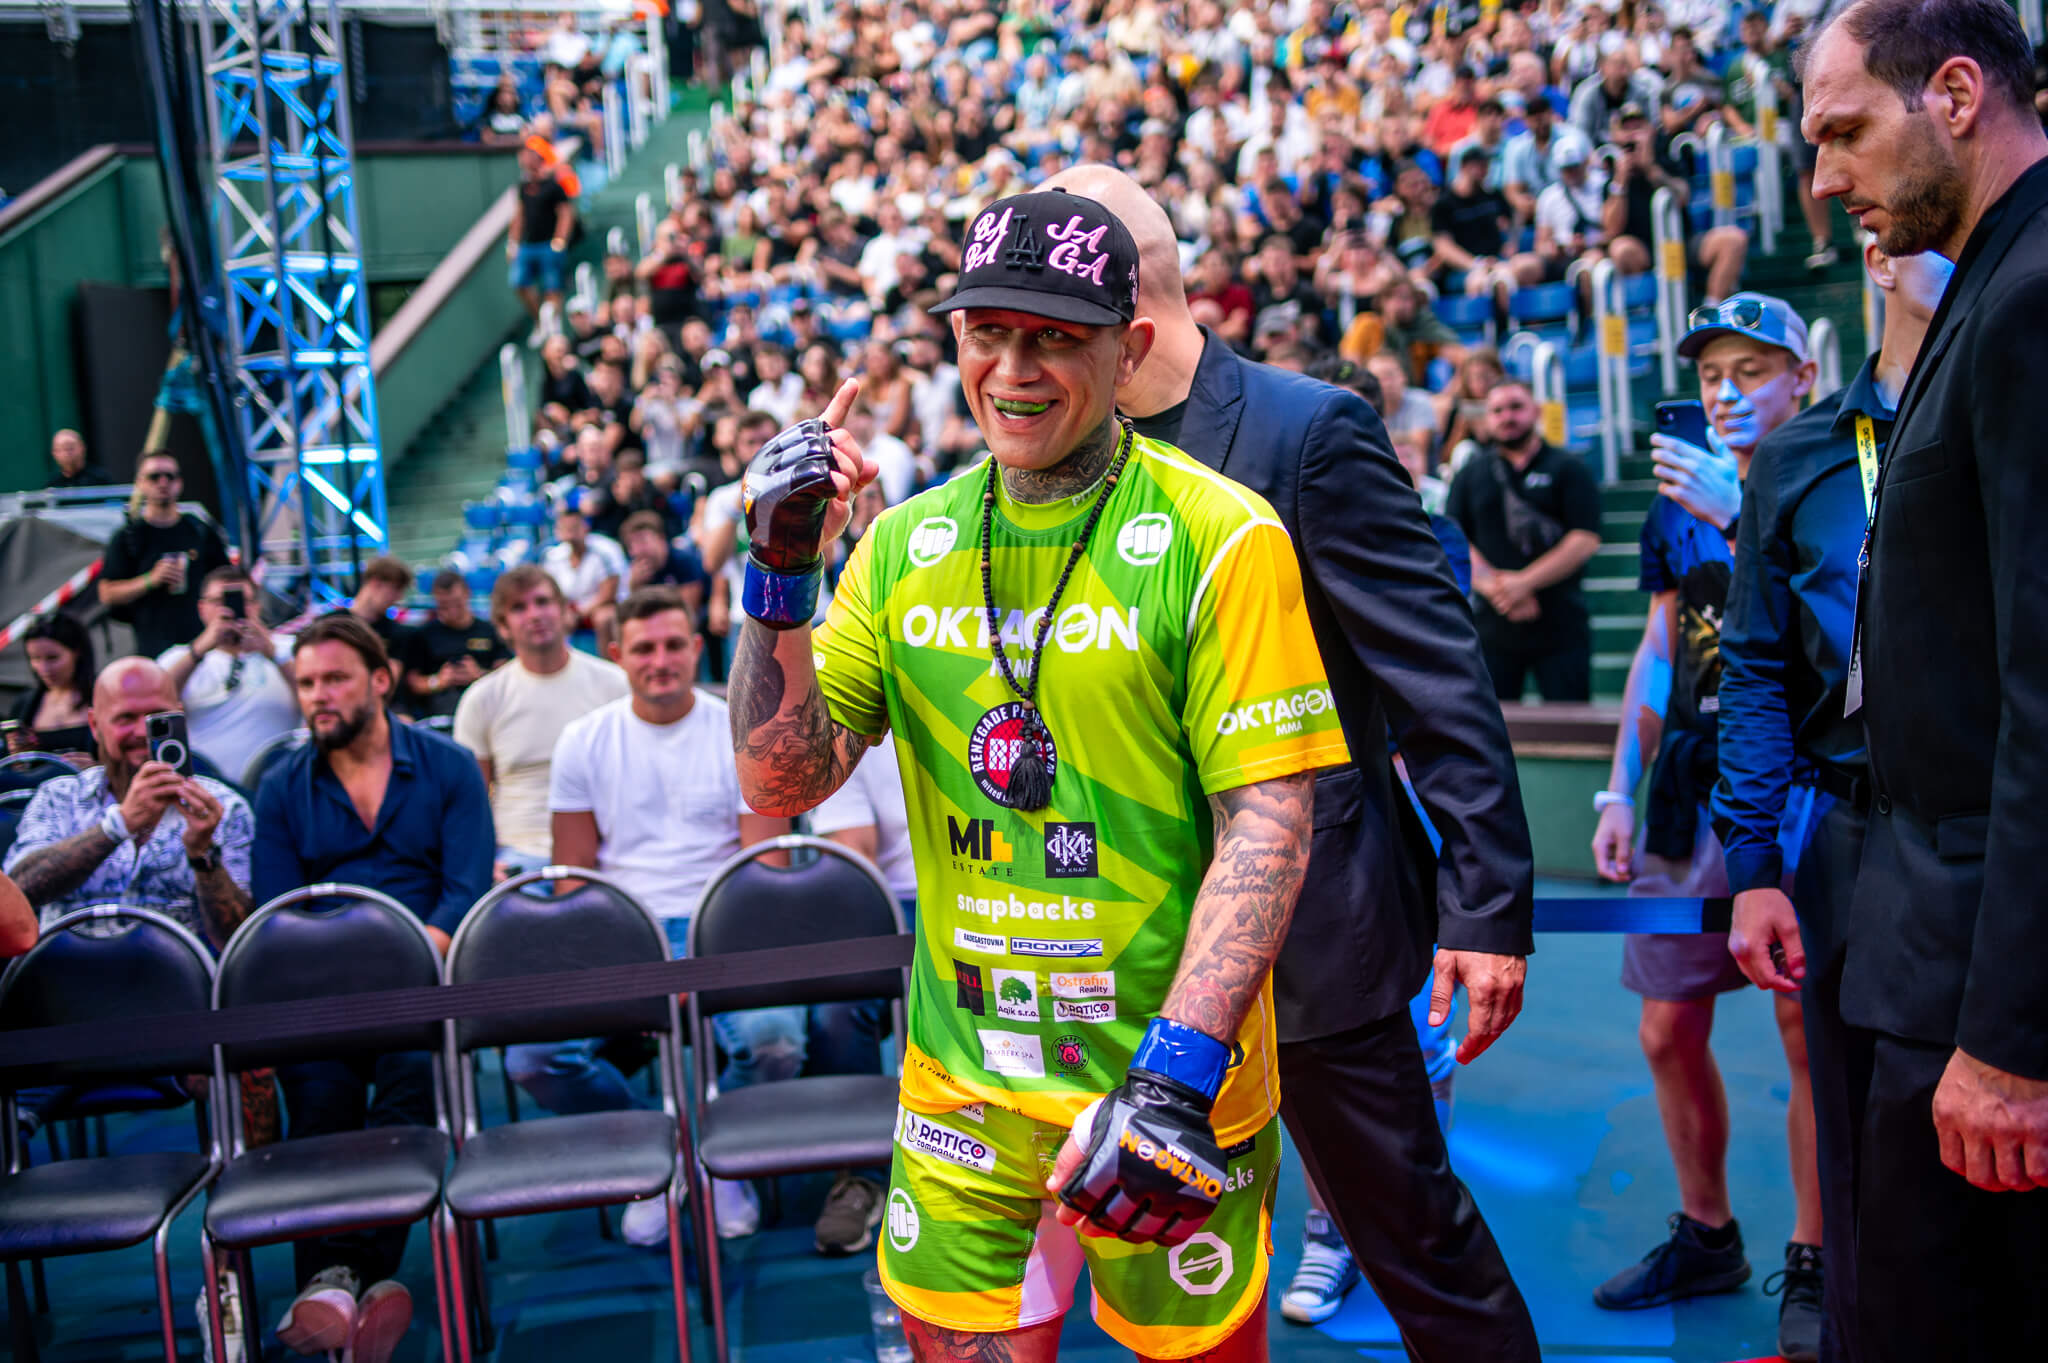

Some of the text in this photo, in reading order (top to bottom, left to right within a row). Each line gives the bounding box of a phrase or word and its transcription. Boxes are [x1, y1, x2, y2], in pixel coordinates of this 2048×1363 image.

[974, 207, 1014, 242] BA
[1046, 215, 1109, 254] JA
[964, 234, 1003, 273] BA
[1005, 214, 1045, 270] LA
[1048, 242, 1110, 287] GA
[903, 603, 1140, 653] OKTAGON
[970, 706, 1009, 773] RENEGADE
[1275, 720, 1303, 736] MMA
[952, 860, 1014, 877] ESTATE
[957, 893, 1096, 924] snapbacks
[1013, 941, 1100, 955] IRONEX
[1056, 974, 1109, 988] Ostrafin
[1079, 985, 1108, 994] Reality
[1017, 1009, 1039, 1017] s.r.o.
[1068, 1002, 1110, 1015] RATICO
[916, 1139, 955, 1160] company
[918, 1122, 987, 1160] RATICO
[1166, 1143, 1192, 1163] MMA
[1118, 1129, 1222, 1198] OKTAGON
